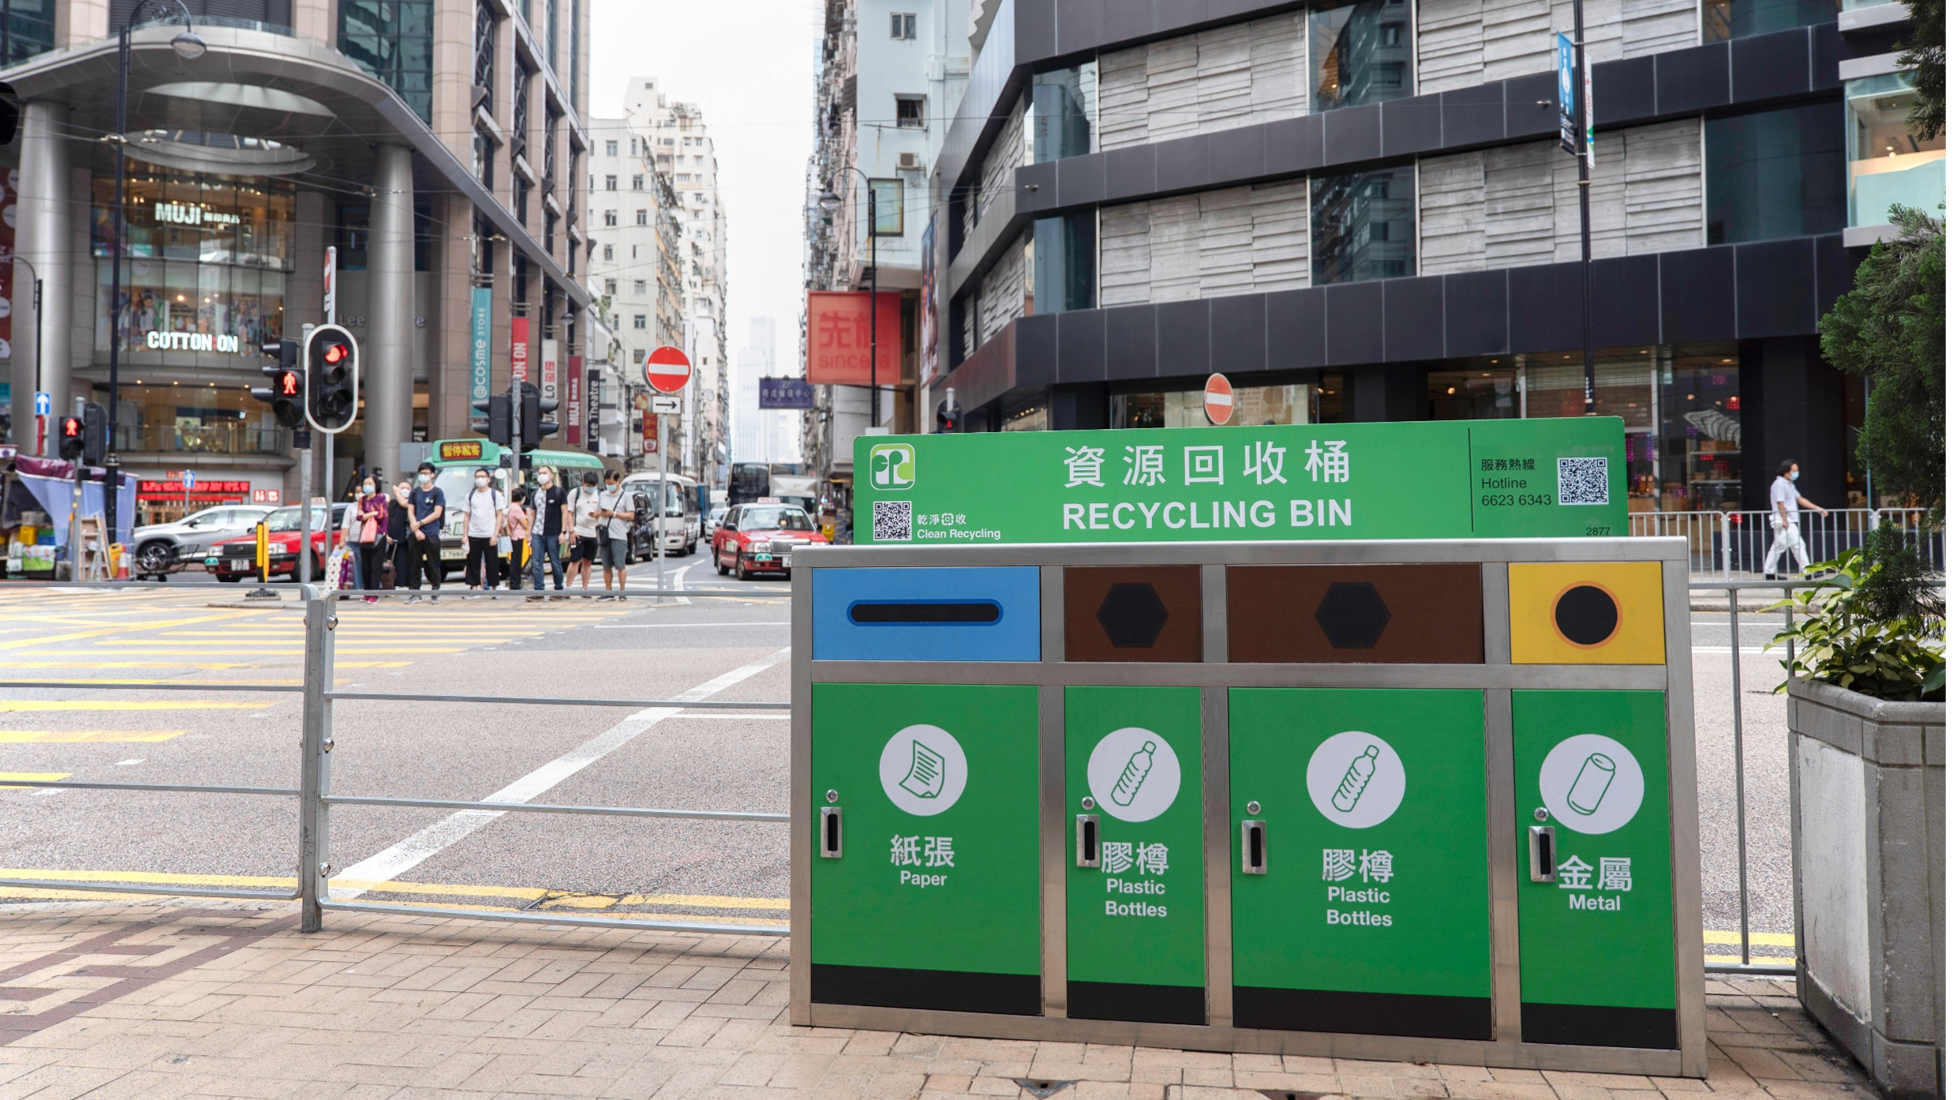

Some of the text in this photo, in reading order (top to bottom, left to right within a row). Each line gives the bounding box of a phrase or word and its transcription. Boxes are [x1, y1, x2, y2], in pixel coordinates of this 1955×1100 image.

[155, 203, 201, 225] MUJI
[474, 307, 487, 398] @cosme STORE
[818, 353, 891, 370] sincee
[569, 401, 580, 426] MUJI
[589, 380, 599, 442] Lee Theatre
[1063, 439, 1350, 489] 資源回收桶
[1480, 457, 1536, 471] 服務熱線
[1481, 477, 1528, 489] Hotline
[1481, 493, 1552, 506] 6623 6343
[1062, 498, 1353, 531] RECYCLING BIN
[916, 528, 1001, 541] Clean Recycling
[1585, 526, 1611, 536] 2877
[889, 834, 955, 868] 紙張
[1101, 841, 1170, 876] 膠樽
[1321, 848, 1394, 883] 膠樽
[1557, 854, 1633, 892] 金屬
[900, 870, 948, 889] Paper
[1106, 878, 1166, 895] Plastic
[1327, 886, 1391, 903] Plastic
[1569, 893, 1621, 911] Metal
[1105, 900, 1168, 917] Bottles
[1326, 909, 1393, 927] Bottles
